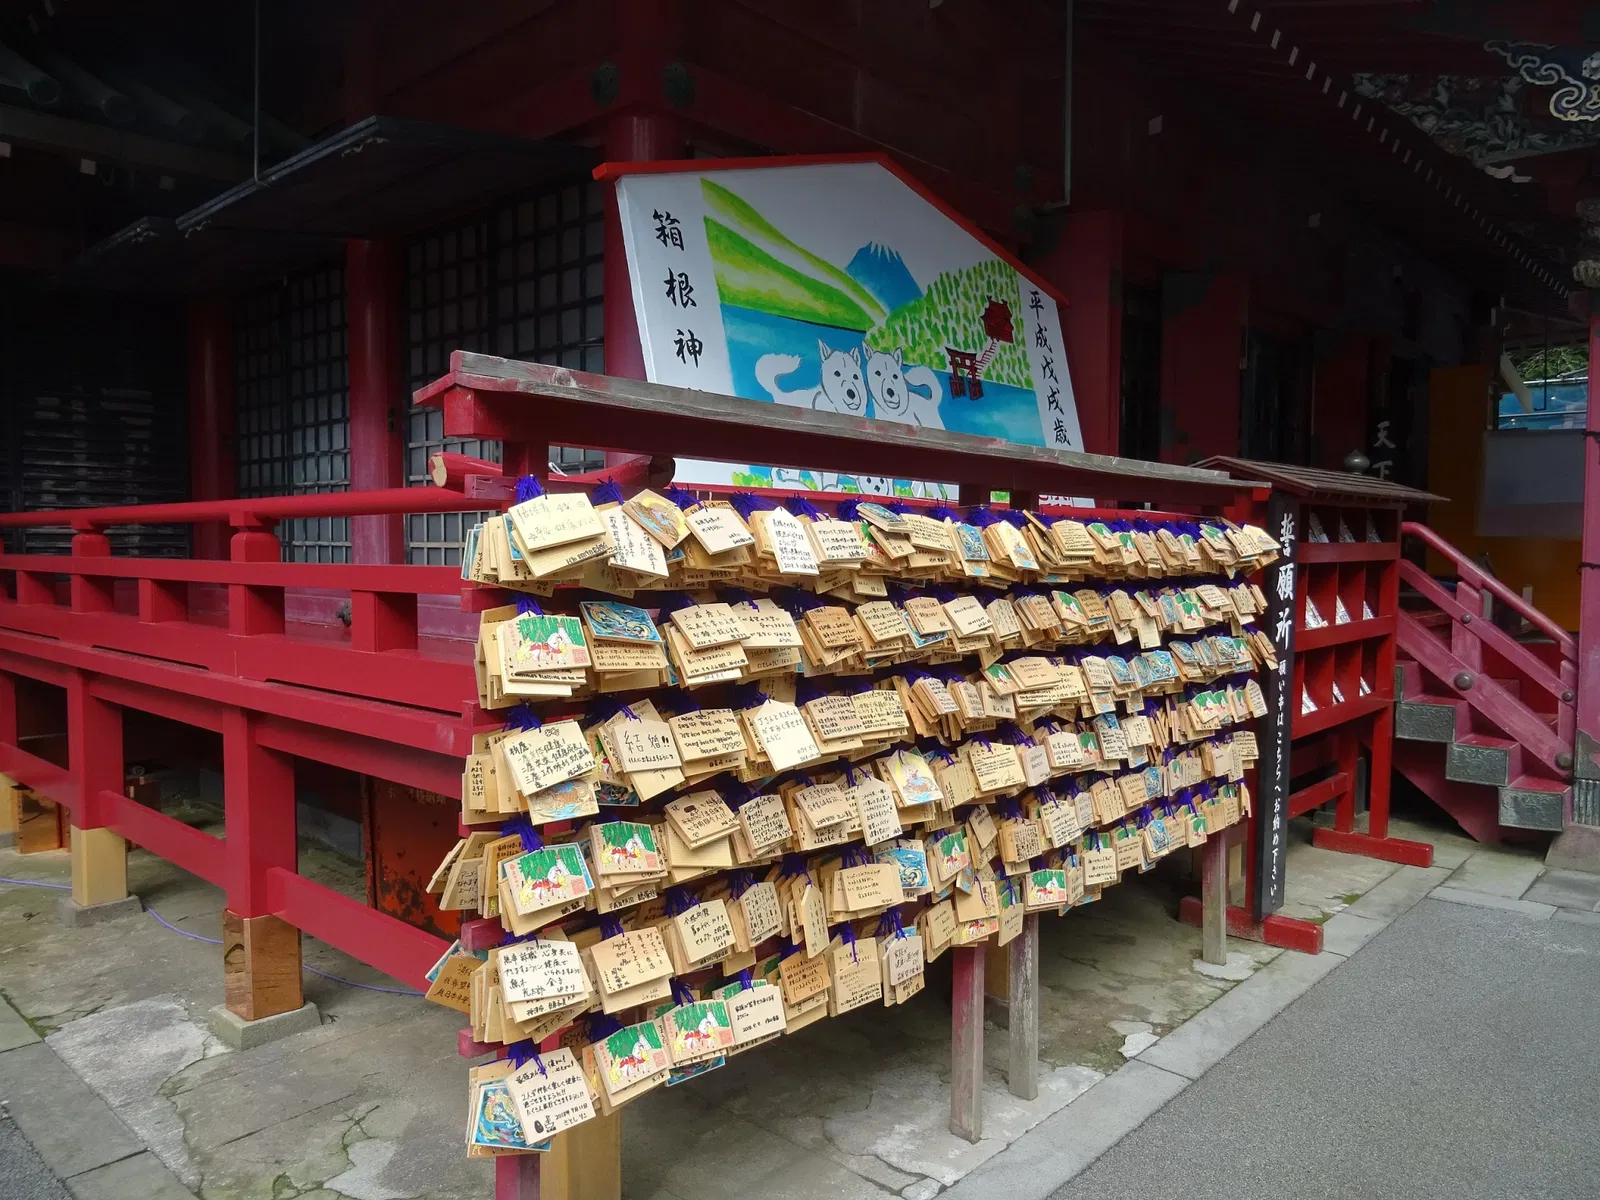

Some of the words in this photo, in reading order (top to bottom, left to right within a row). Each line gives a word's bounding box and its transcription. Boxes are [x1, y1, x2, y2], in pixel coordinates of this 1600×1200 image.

[652, 207, 704, 391] 箱根神
[1276, 512, 1295, 651] 誓願所
